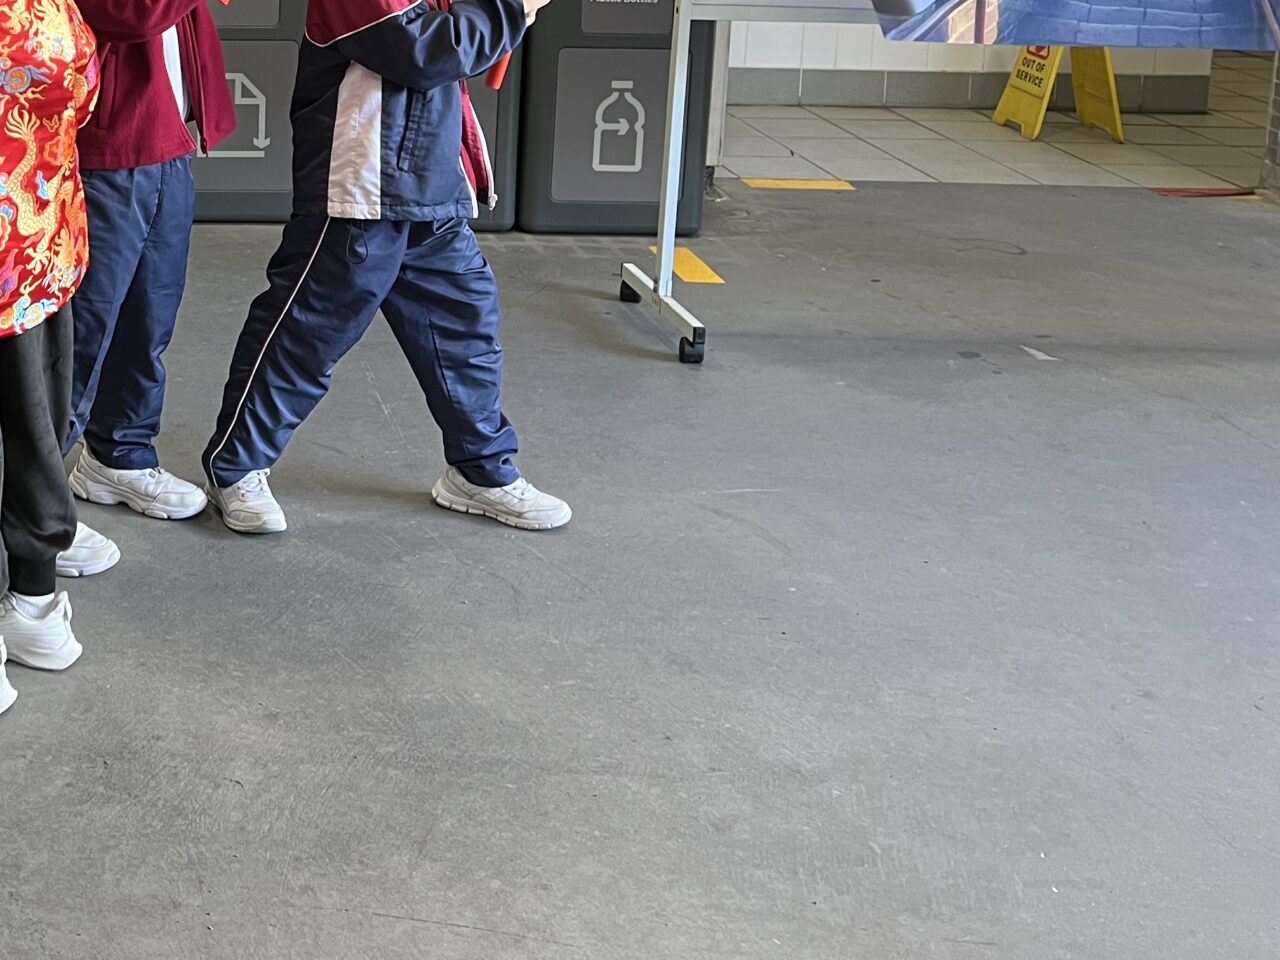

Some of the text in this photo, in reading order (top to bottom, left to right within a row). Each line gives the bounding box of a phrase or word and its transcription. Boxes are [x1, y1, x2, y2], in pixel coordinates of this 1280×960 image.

[1022, 57, 1046, 73] OUT OF
[1016, 69, 1043, 88] SERVICE
